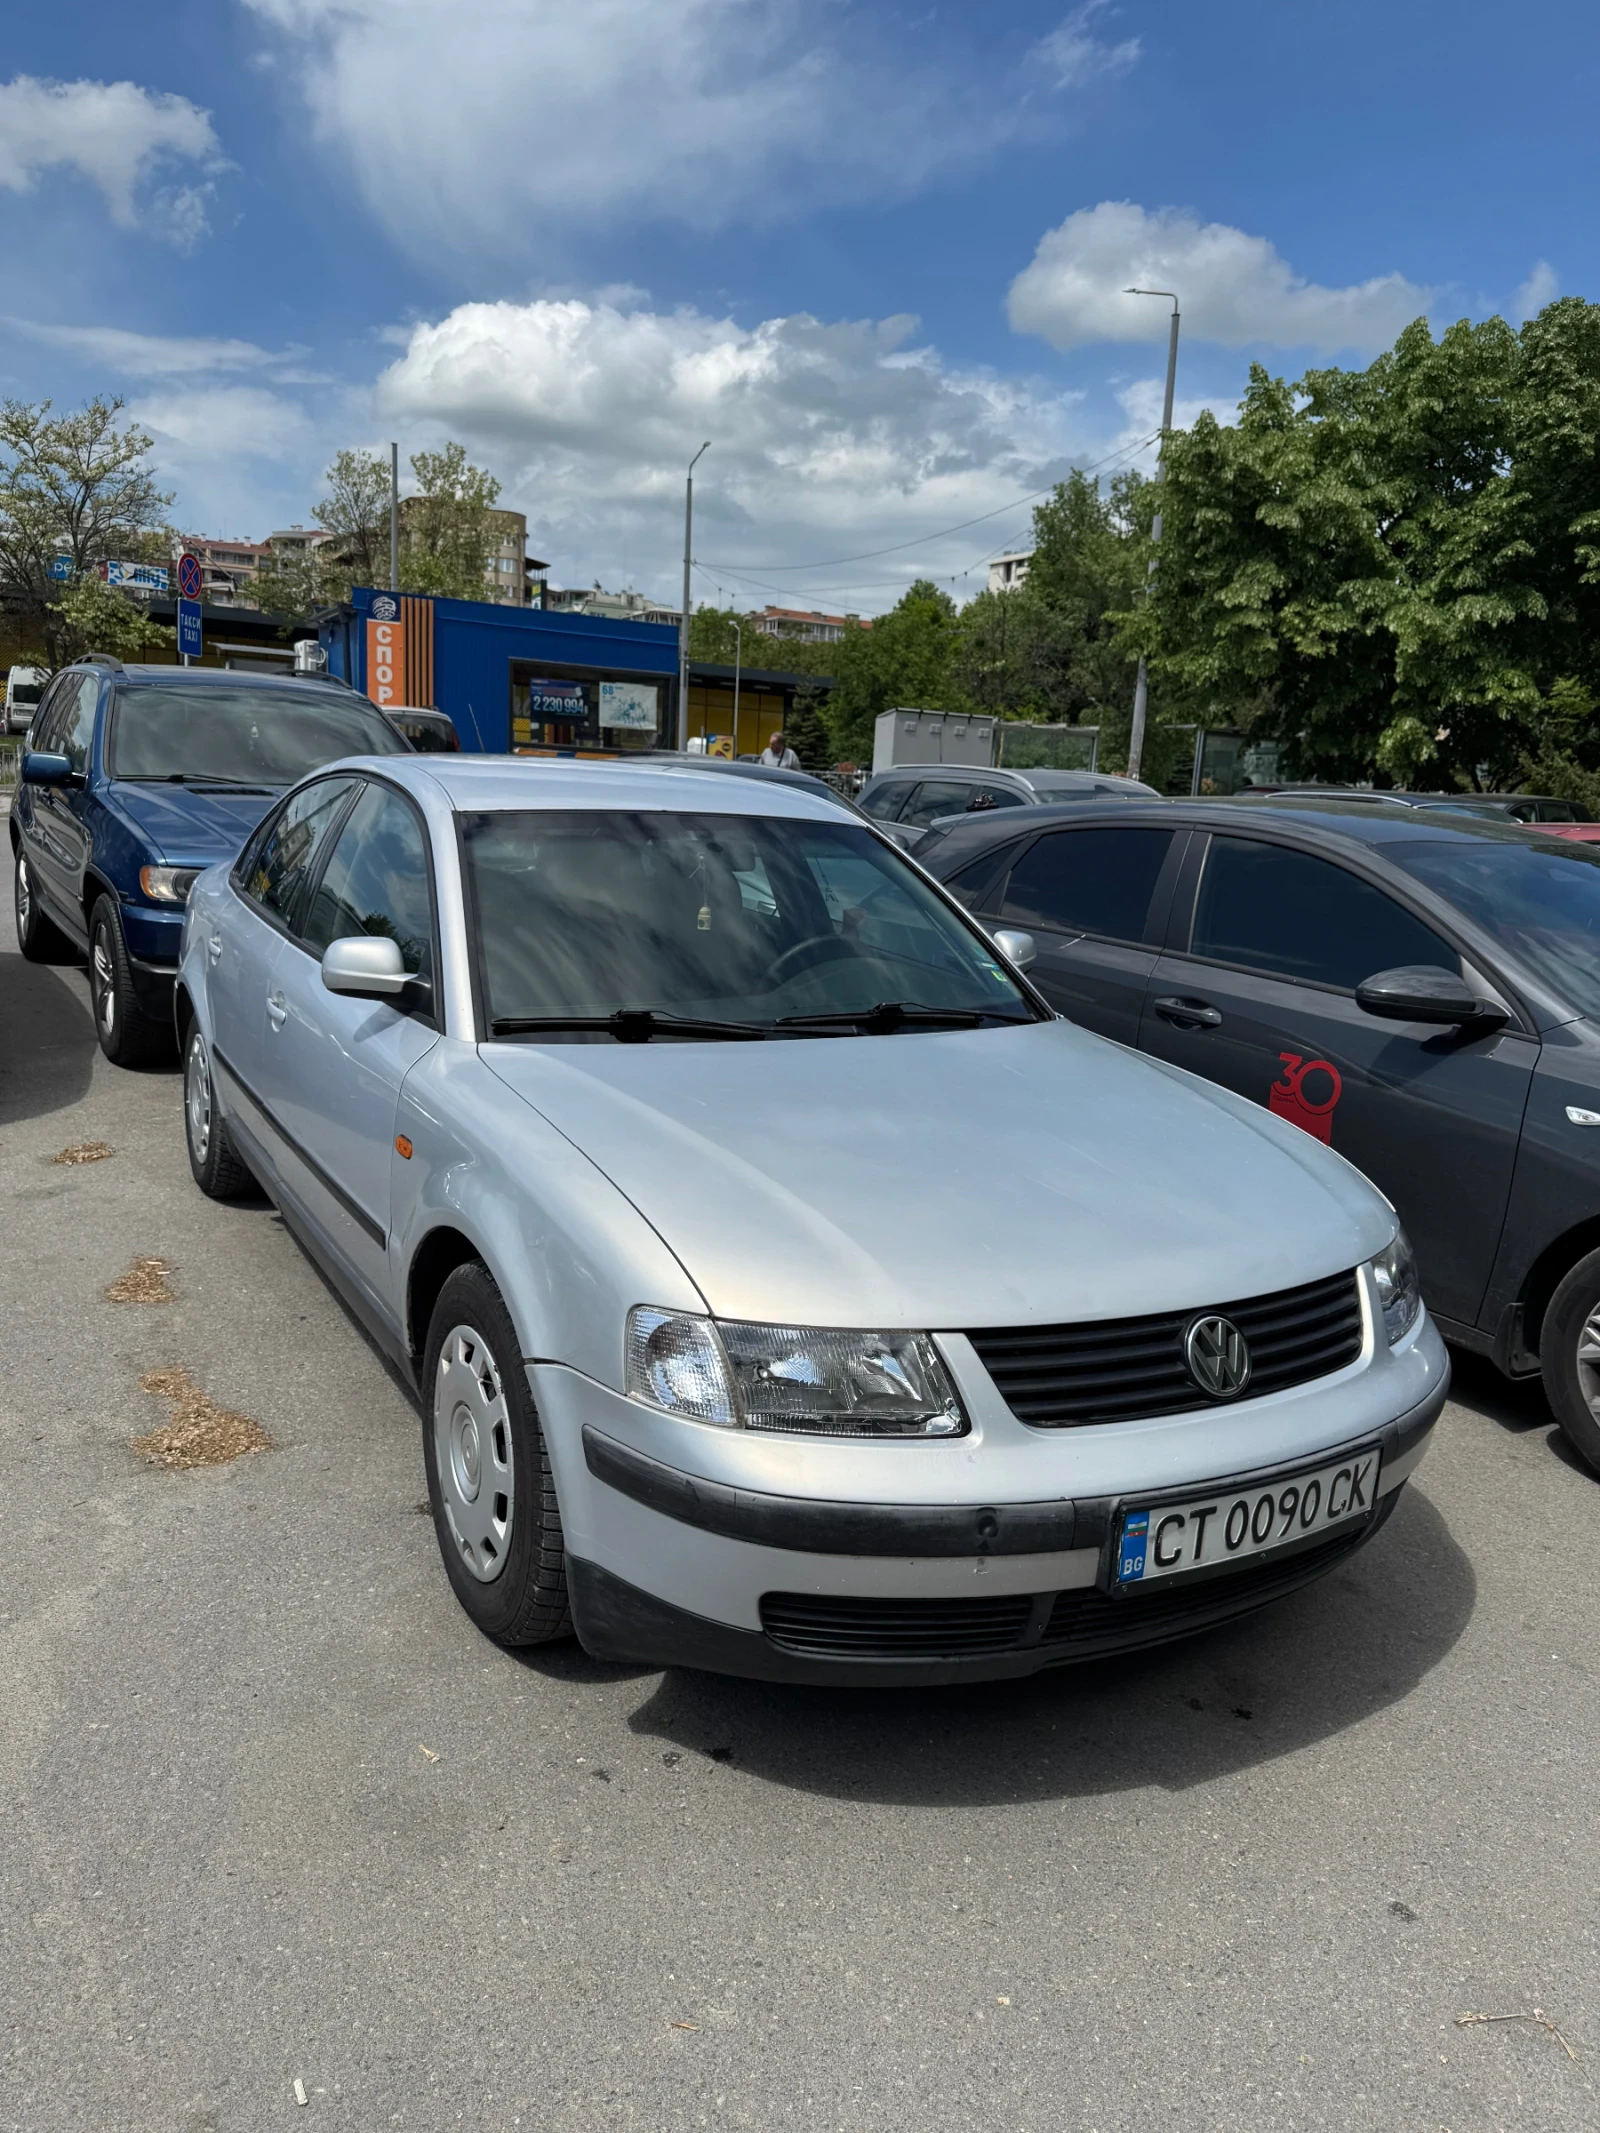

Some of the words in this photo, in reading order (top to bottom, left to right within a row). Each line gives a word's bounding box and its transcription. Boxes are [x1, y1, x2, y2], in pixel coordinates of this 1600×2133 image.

[180, 613, 201, 630] ТАКСИ
[183, 628, 198, 643] TAXI
[1272, 1051, 1342, 1115] 30
[1123, 1555, 1144, 1576] BG
